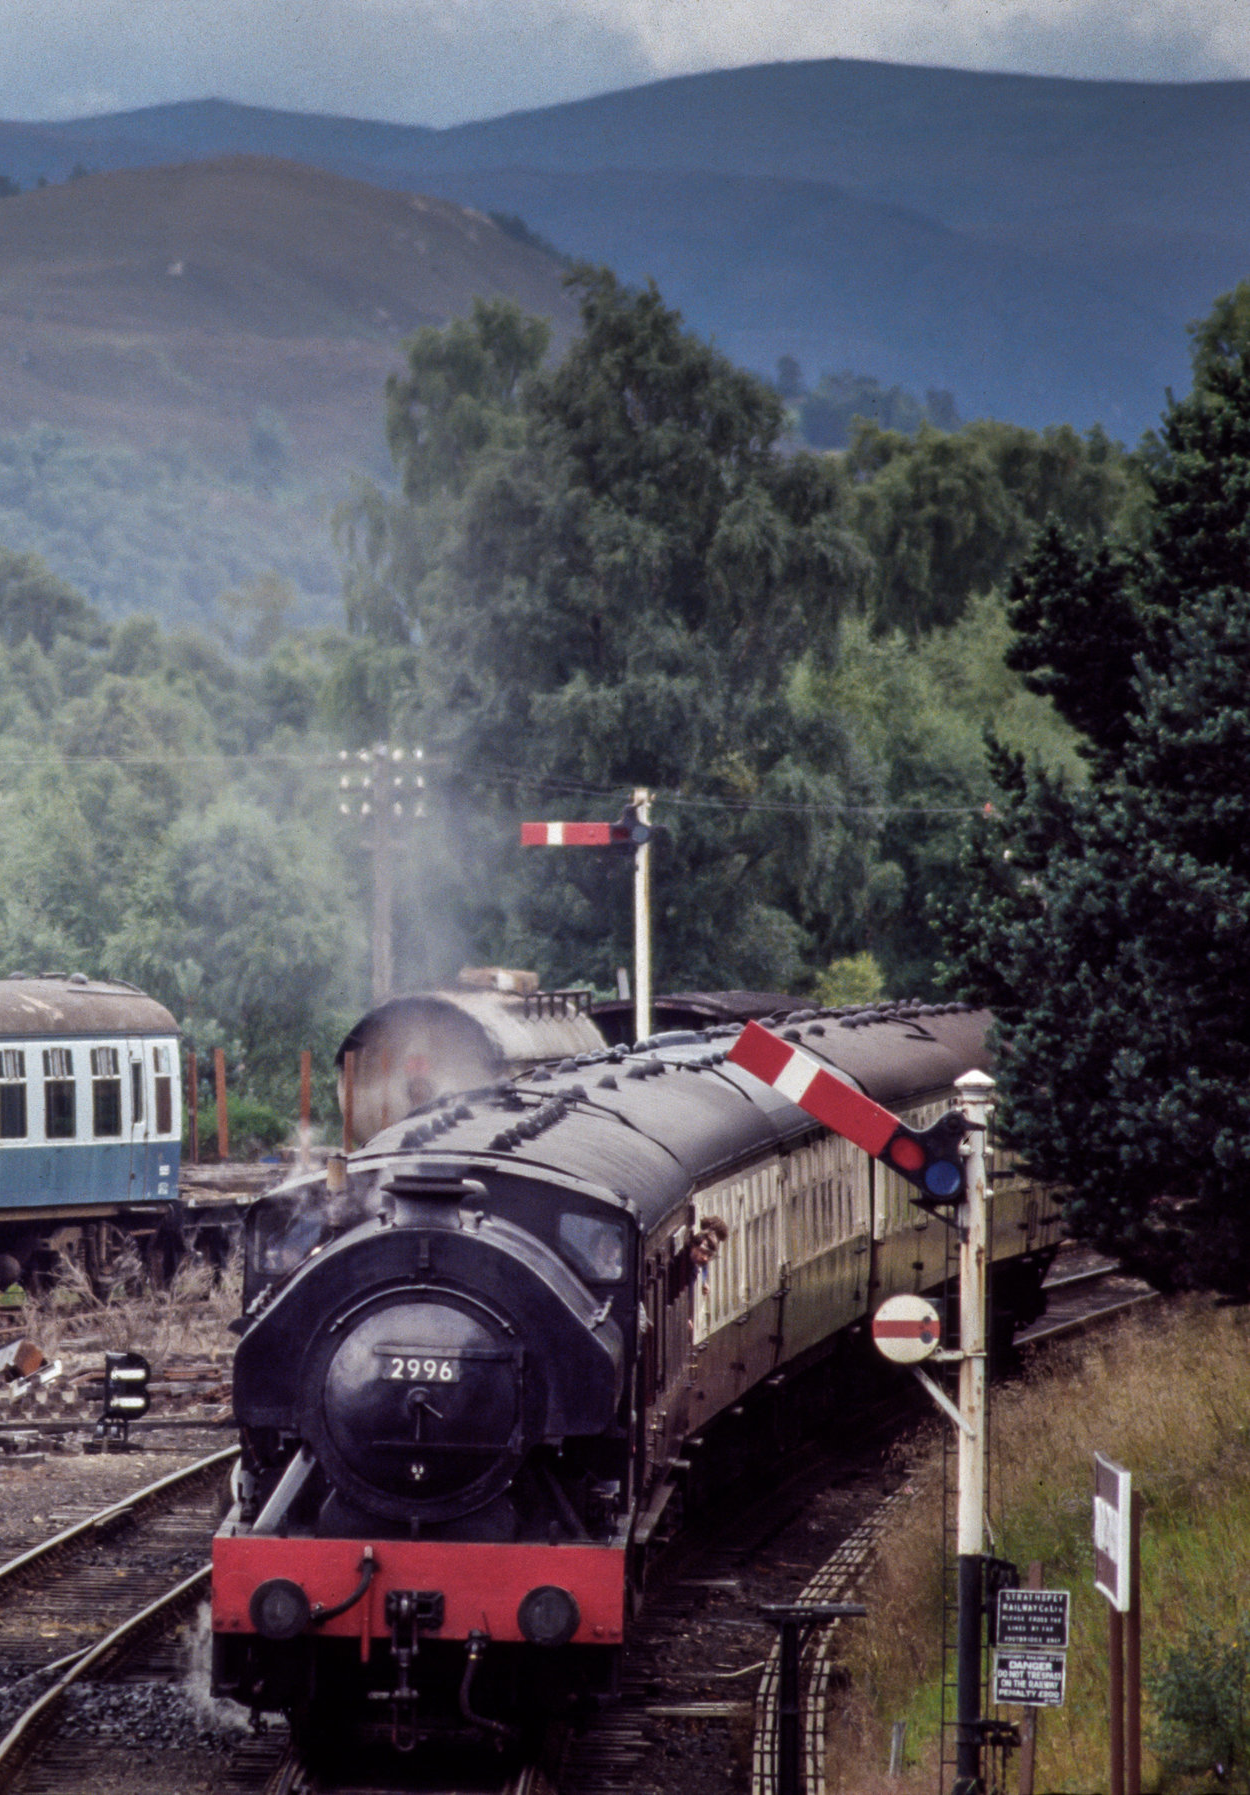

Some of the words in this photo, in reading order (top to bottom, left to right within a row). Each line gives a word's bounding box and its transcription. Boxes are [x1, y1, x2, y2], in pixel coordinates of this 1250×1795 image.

[391, 1358, 453, 1380] 2996
[1005, 1593, 1064, 1602] STRATHSPEY
[1002, 1603, 1038, 1612] RAILWAY
[1008, 1660, 1053, 1671] DANGER
[997, 1669, 1008, 1678] DO
[1008, 1670, 1025, 1679] NOT
[1027, 1671, 1062, 1680] TRESPASS
[1000, 1678, 1012, 1687] ON
[1013, 1679, 1027, 1688] THE
[1028, 1680, 1059, 1689] RAILWAY
[998, 1688, 1037, 1698] PENALTY
